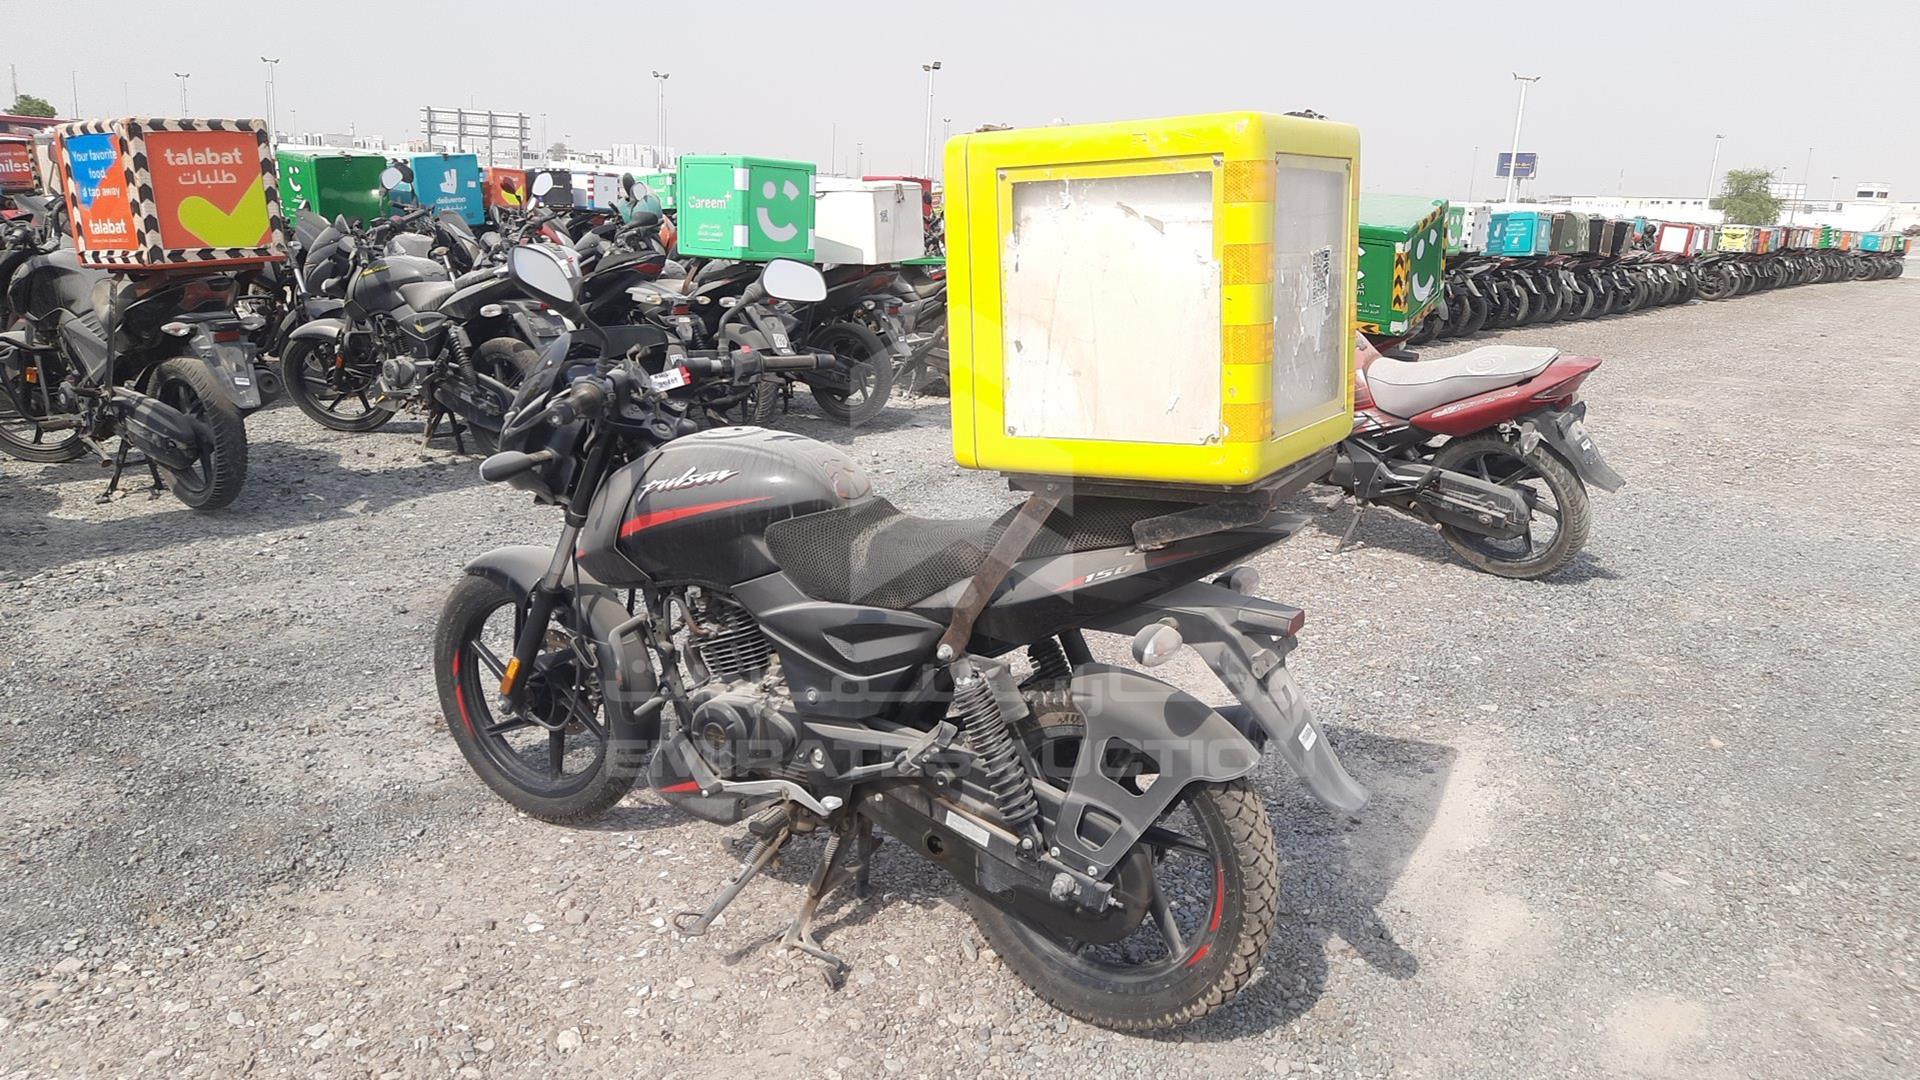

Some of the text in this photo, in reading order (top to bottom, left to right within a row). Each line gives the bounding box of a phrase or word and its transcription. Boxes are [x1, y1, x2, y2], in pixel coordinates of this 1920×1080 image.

[71, 149, 118, 162] Your favorite
[164, 147, 243, 166] talabat
[178, 169, 237, 189] طلبات
[89, 188, 101, 199] tap
[102, 187, 121, 198] away
[89, 219, 127, 234] talabat
[1085, 564, 1132, 583] 150
